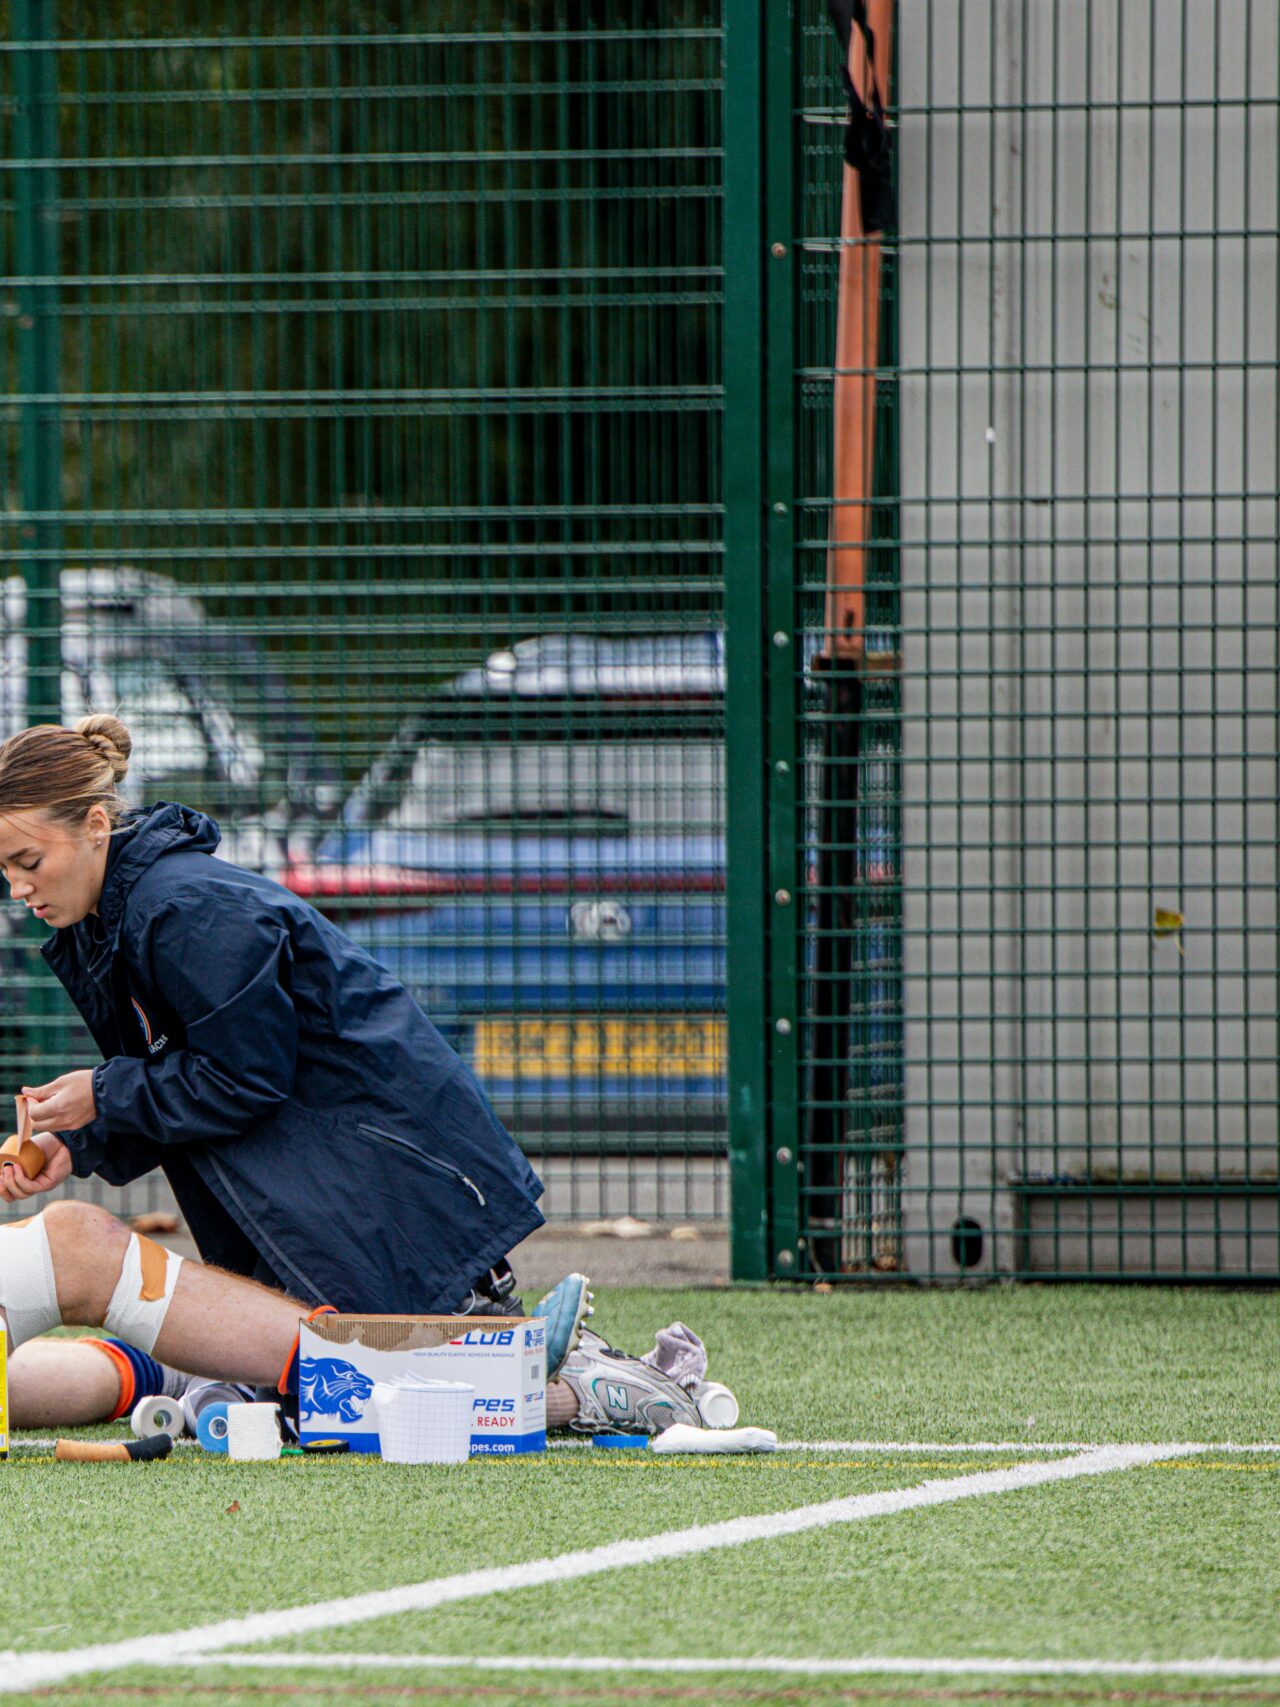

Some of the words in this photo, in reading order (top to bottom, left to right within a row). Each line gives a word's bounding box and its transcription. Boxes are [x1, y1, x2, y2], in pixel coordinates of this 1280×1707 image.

[449, 1330, 515, 1346] LUB
[477, 1416, 515, 1427] READY
[469, 1442, 515, 1454] pes.com
